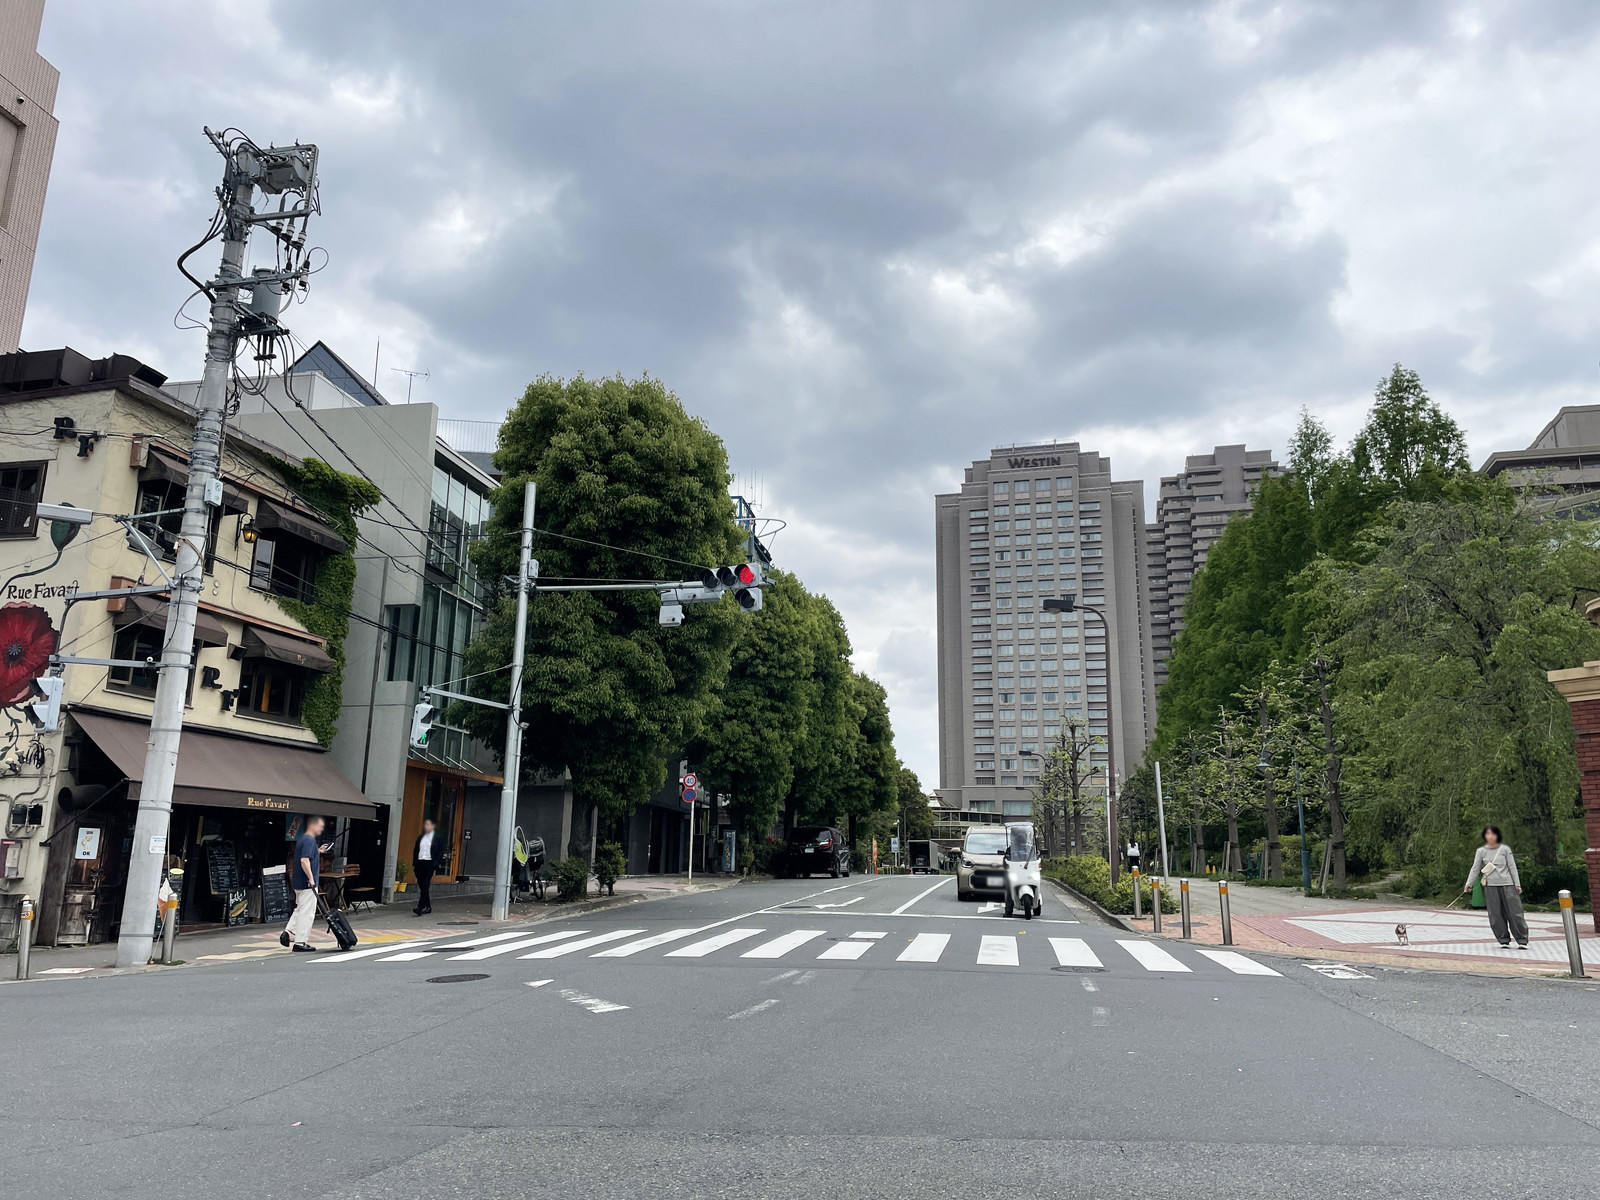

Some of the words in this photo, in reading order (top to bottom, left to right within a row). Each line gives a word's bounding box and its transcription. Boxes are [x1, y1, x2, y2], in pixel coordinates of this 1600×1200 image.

[1007, 456, 1061, 469] WESTIN
[6, 584, 33, 600] Rue
[201, 665, 223, 689] R
[686, 777, 694, 785] 40
[247, 797, 264, 808] Rue
[265, 797, 290, 809] Favart
